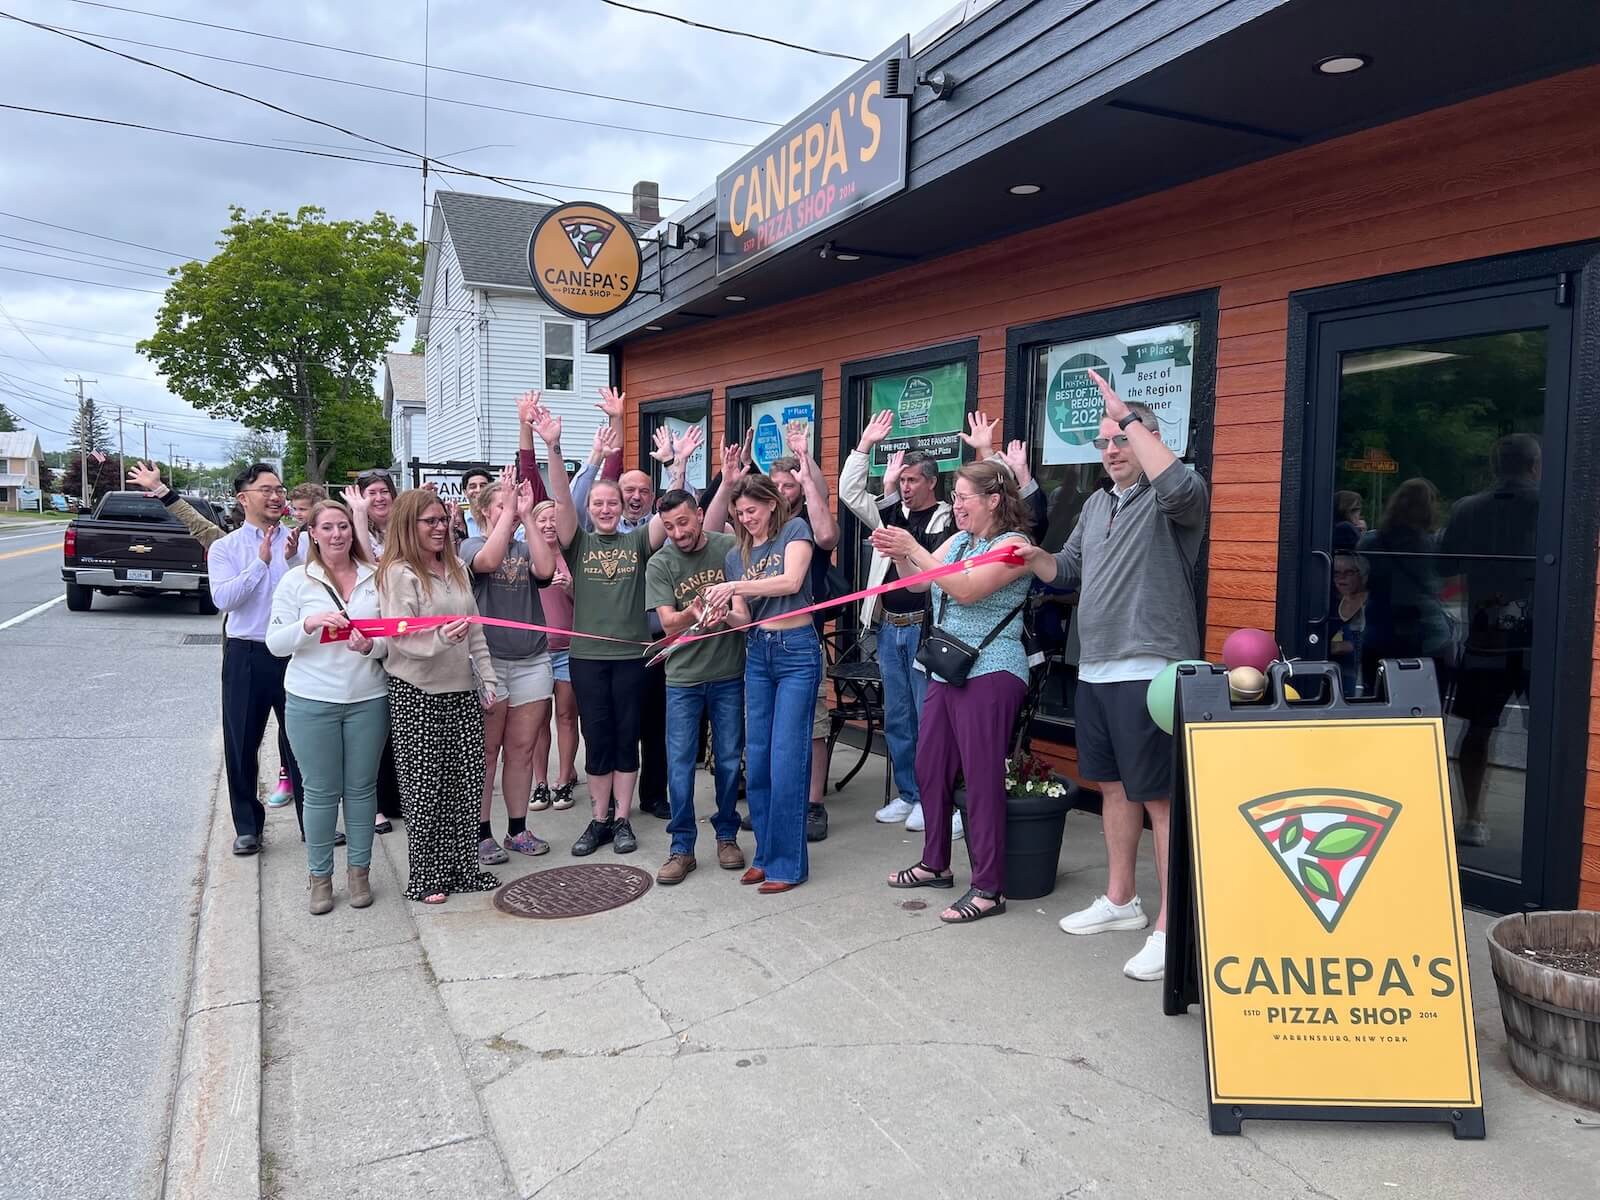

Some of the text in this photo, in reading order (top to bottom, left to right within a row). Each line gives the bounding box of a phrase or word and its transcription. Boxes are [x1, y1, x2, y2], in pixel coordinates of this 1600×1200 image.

[728, 80, 882, 238] CANEPA'S
[757, 208, 793, 250] PIZZA
[796, 184, 836, 229] SHOP
[544, 268, 629, 291] CANEPA'S
[562, 287, 587, 296] PIZZA
[590, 290, 611, 298] SHOP
[1150, 345, 1175, 357] Place
[1137, 367, 1171, 381] Best of
[1055, 390, 1075, 400] BEST
[1075, 388, 1087, 398] OF
[1128, 384, 1182, 397] the Region
[1071, 397, 1105, 409] REGION
[1144, 400, 1172, 410] inner
[880, 444, 892, 452] THE
[893, 442, 910, 450] PIZZA
[931, 435, 957, 446] FAVORITE
[582, 549, 639, 564] CANEPA'S
[1213, 954, 1456, 998] CANEPA'S
[1243, 1007, 1438, 1026] ESTD PIZZA SHOP 2014
